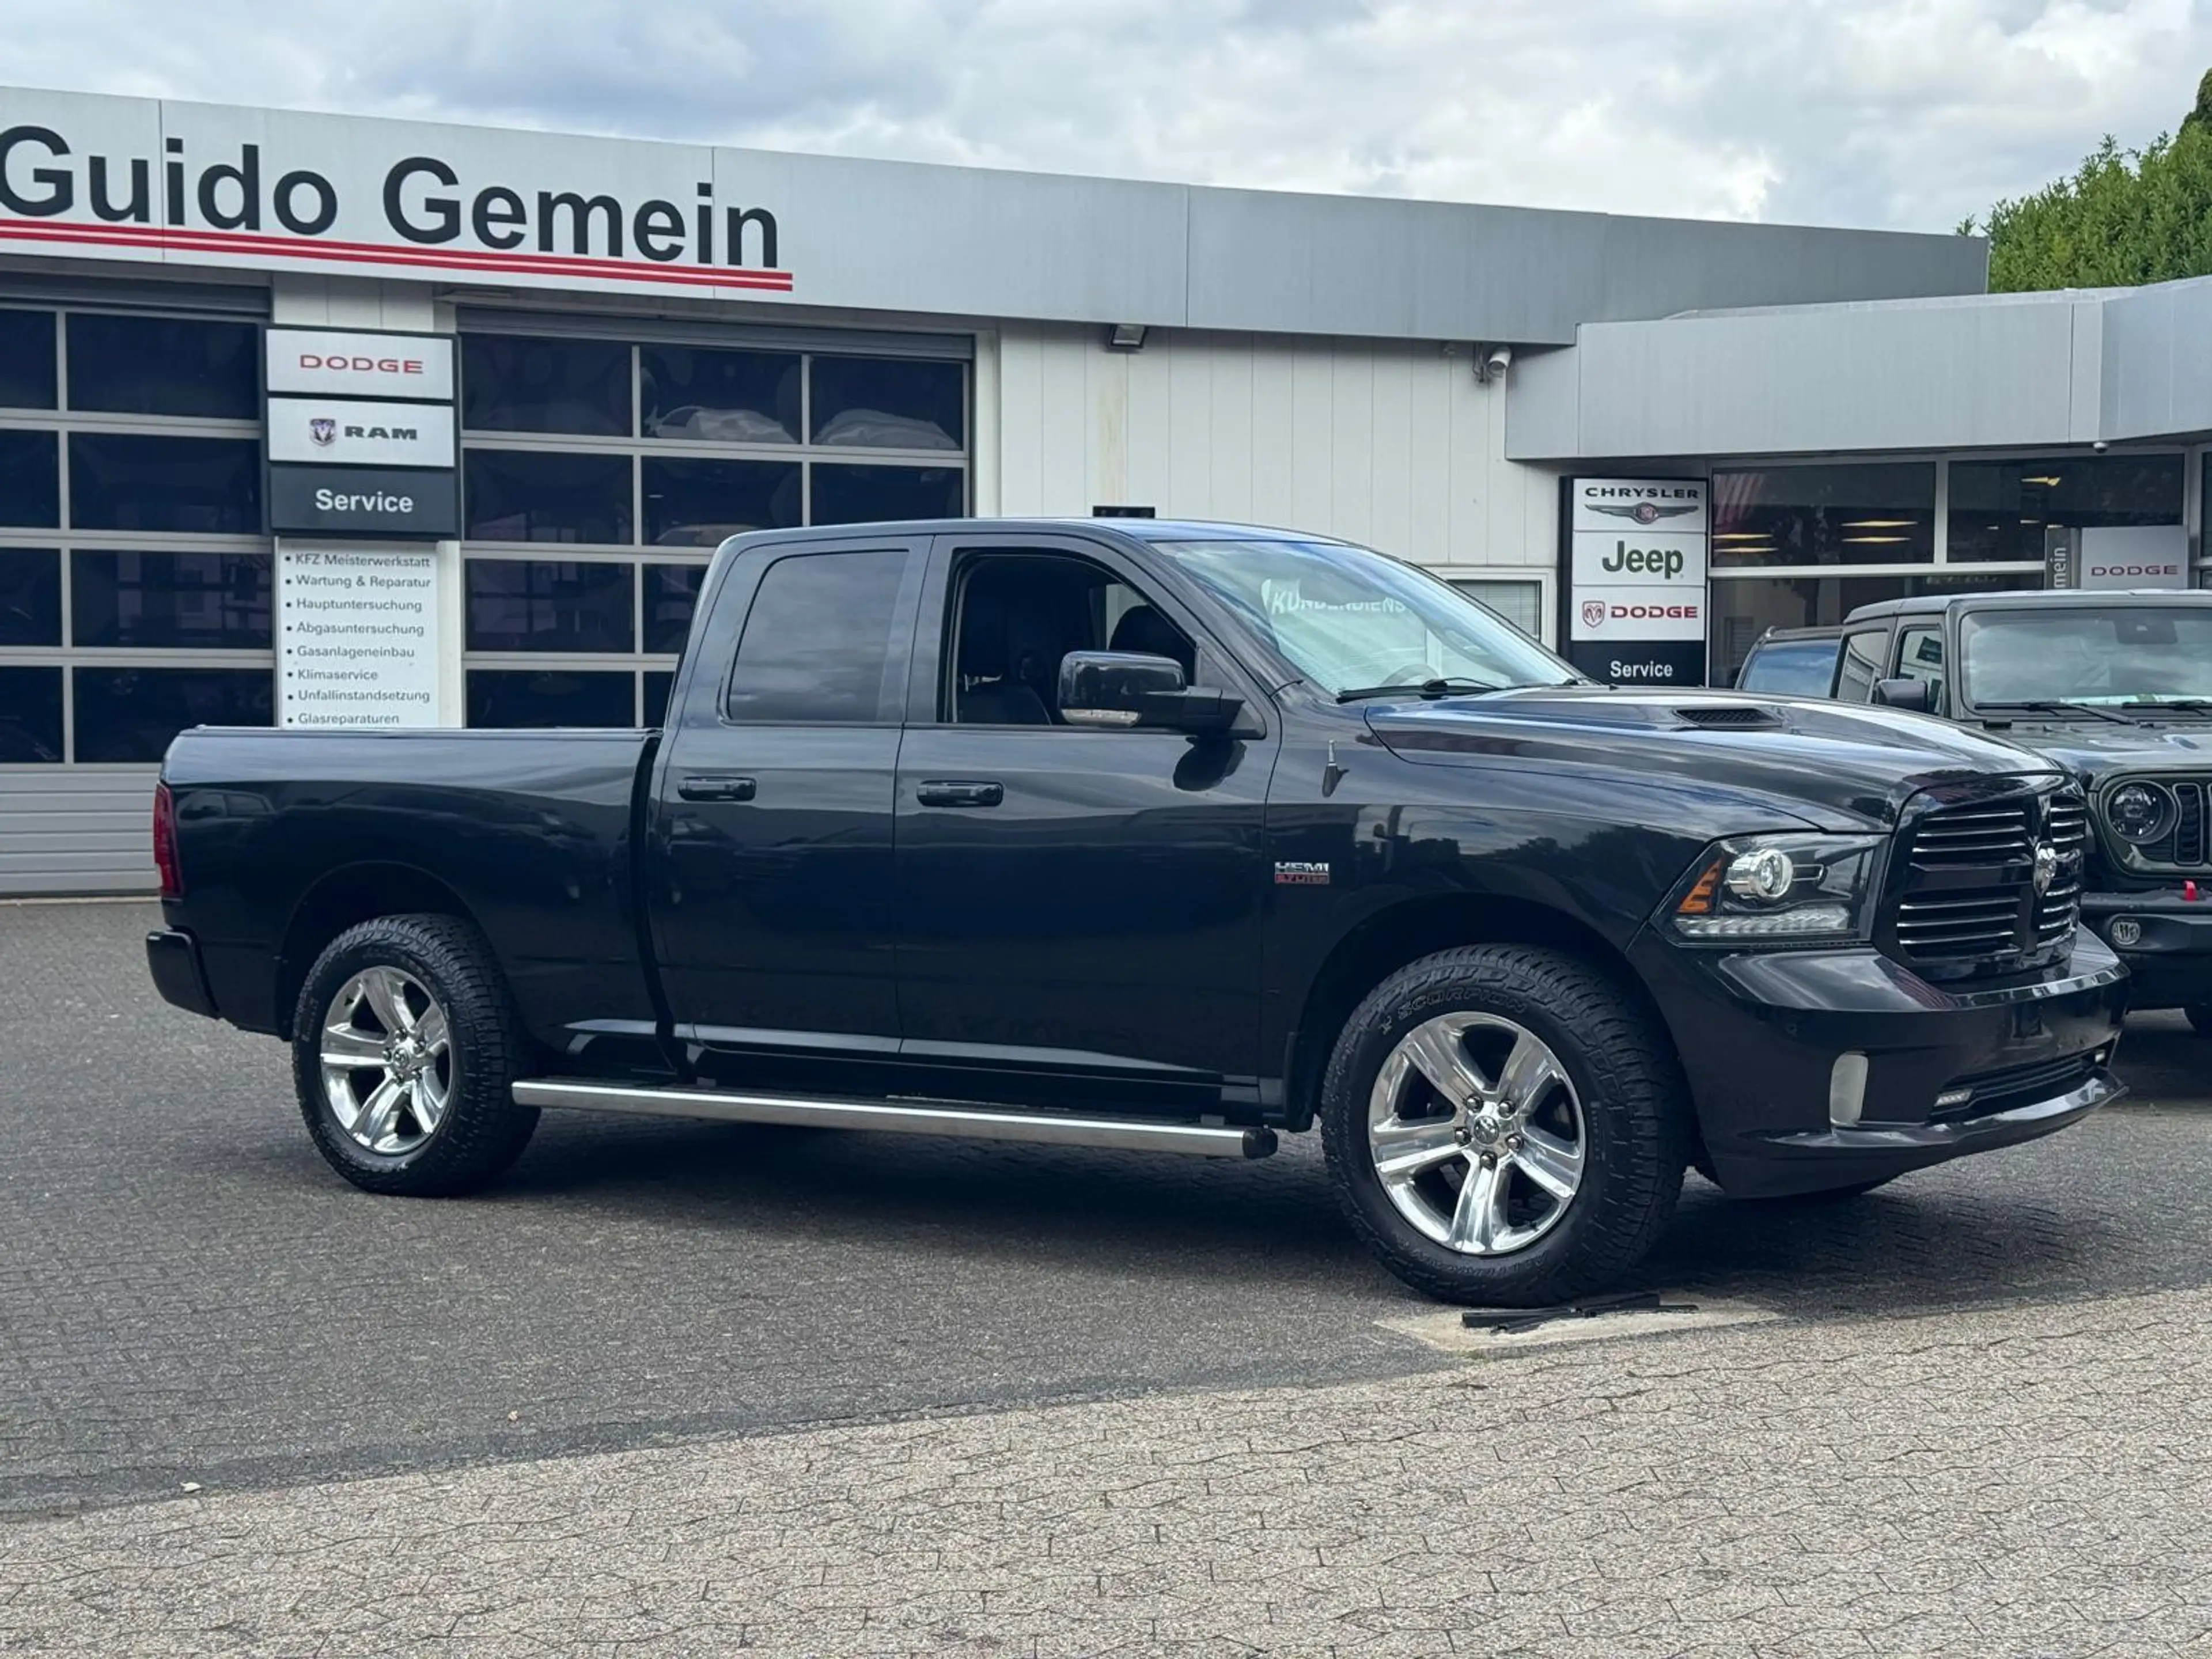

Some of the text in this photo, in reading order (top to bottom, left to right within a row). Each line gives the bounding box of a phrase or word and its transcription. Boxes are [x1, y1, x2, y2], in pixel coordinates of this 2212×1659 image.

[0, 126, 778, 268] Guido Gemein
[300, 354, 424, 374] DODGE
[344, 426, 418, 441] RAM
[1585, 487, 1699, 499] CHRYSLER
[315, 488, 414, 513] Service
[296, 553, 430, 567] KFZ Meisterwerkstatt
[1602, 540, 1684, 579] Jeep
[2091, 565, 2179, 576] DODGE
[296, 575, 431, 589] Wartung & Reparatur
[296, 598, 422, 613] Hauptuntersuchung
[1611, 606, 1698, 619] DODGE
[297, 622, 425, 637] Abgasuntersuchung
[297, 646, 414, 659] Gasanlageneinbau
[298, 669, 378, 680] Klimaservice
[1610, 660, 1673, 677] Service
[298, 690, 430, 703] Unfallinstandsetzung
[298, 713, 400, 726] Glasreparaturen
